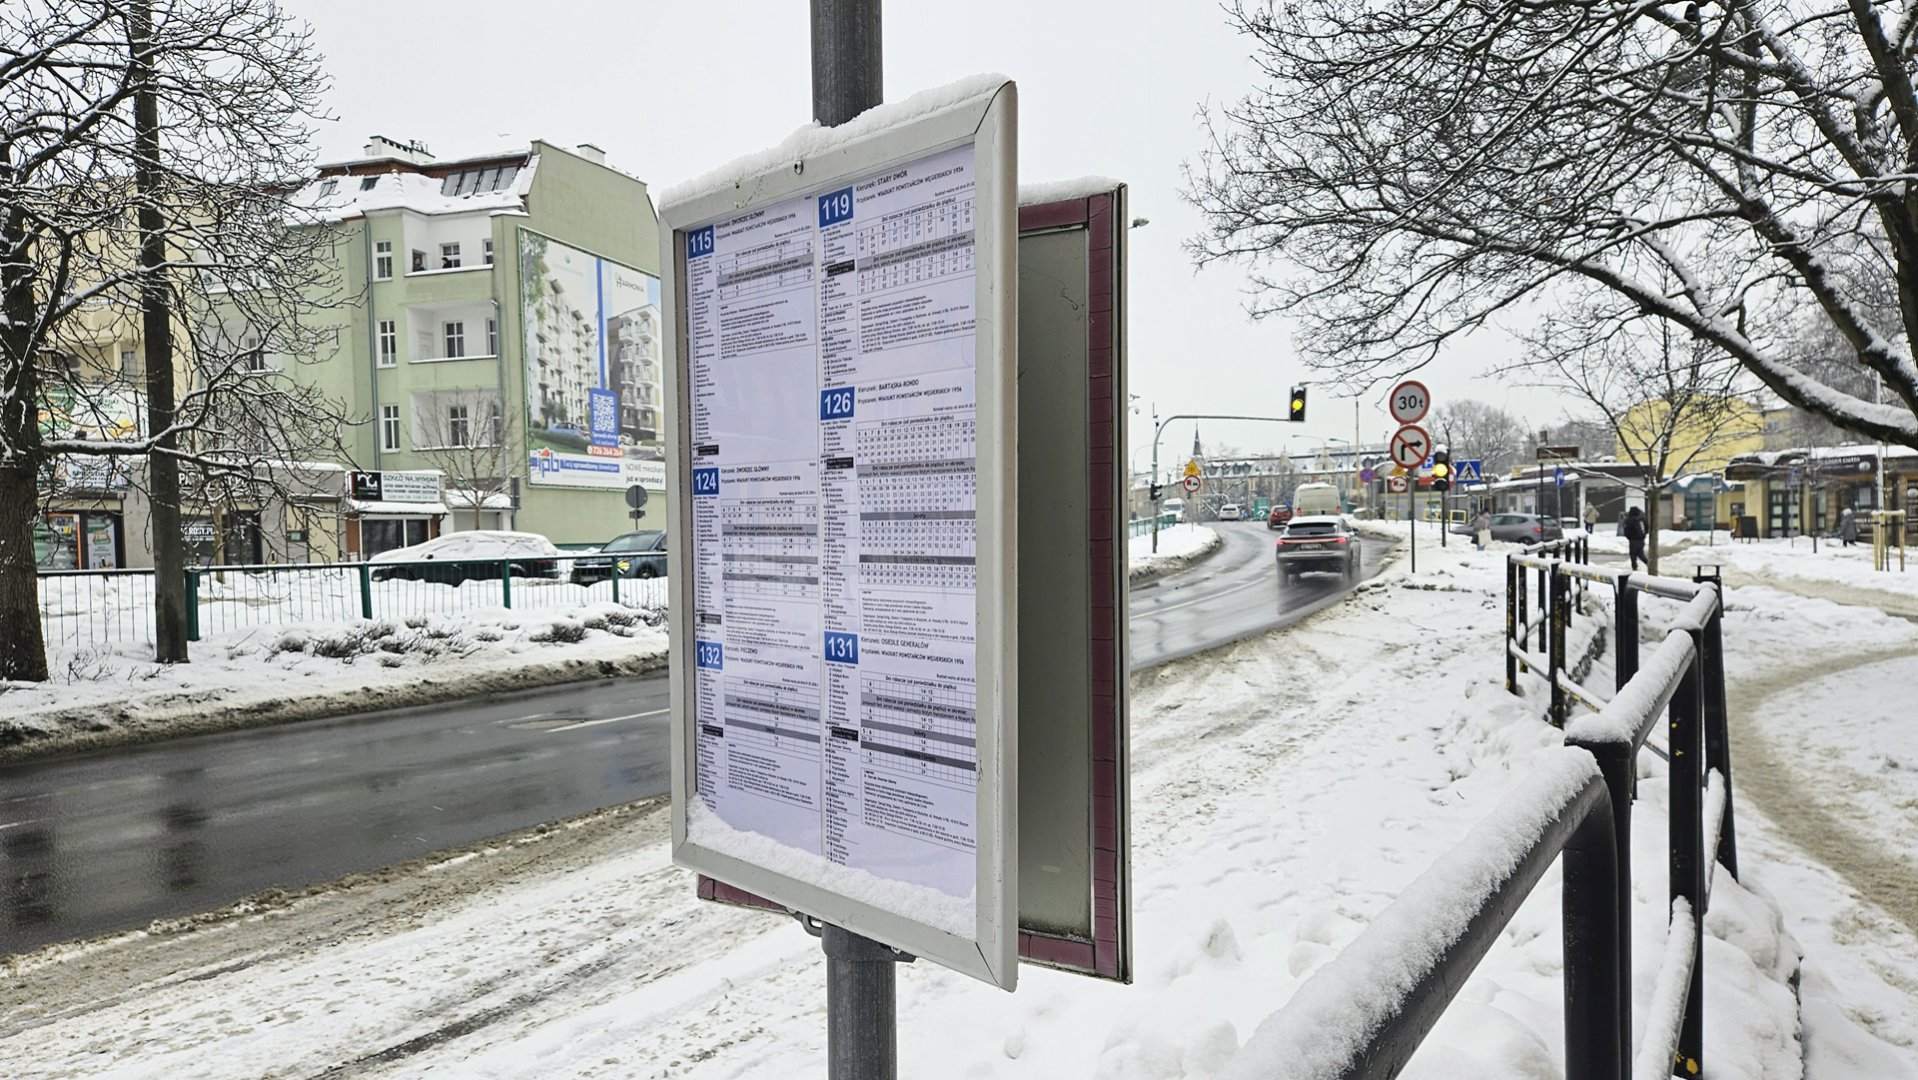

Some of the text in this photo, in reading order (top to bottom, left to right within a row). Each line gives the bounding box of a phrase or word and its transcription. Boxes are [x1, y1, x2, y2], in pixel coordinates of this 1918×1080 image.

[856, 169, 907, 192] Kierunek: STARY DWÓR
[822, 192, 850, 221] 119
[690, 229, 712, 254] 115
[858, 385, 877, 394] Kierunek:
[824, 392, 851, 414] 126
[626, 463, 642, 472] NOWE
[696, 472, 717, 490] 124
[828, 635, 853, 659] 131
[901, 639, 929, 649] GENERAŁÓW
[699, 645, 720, 665] 132
